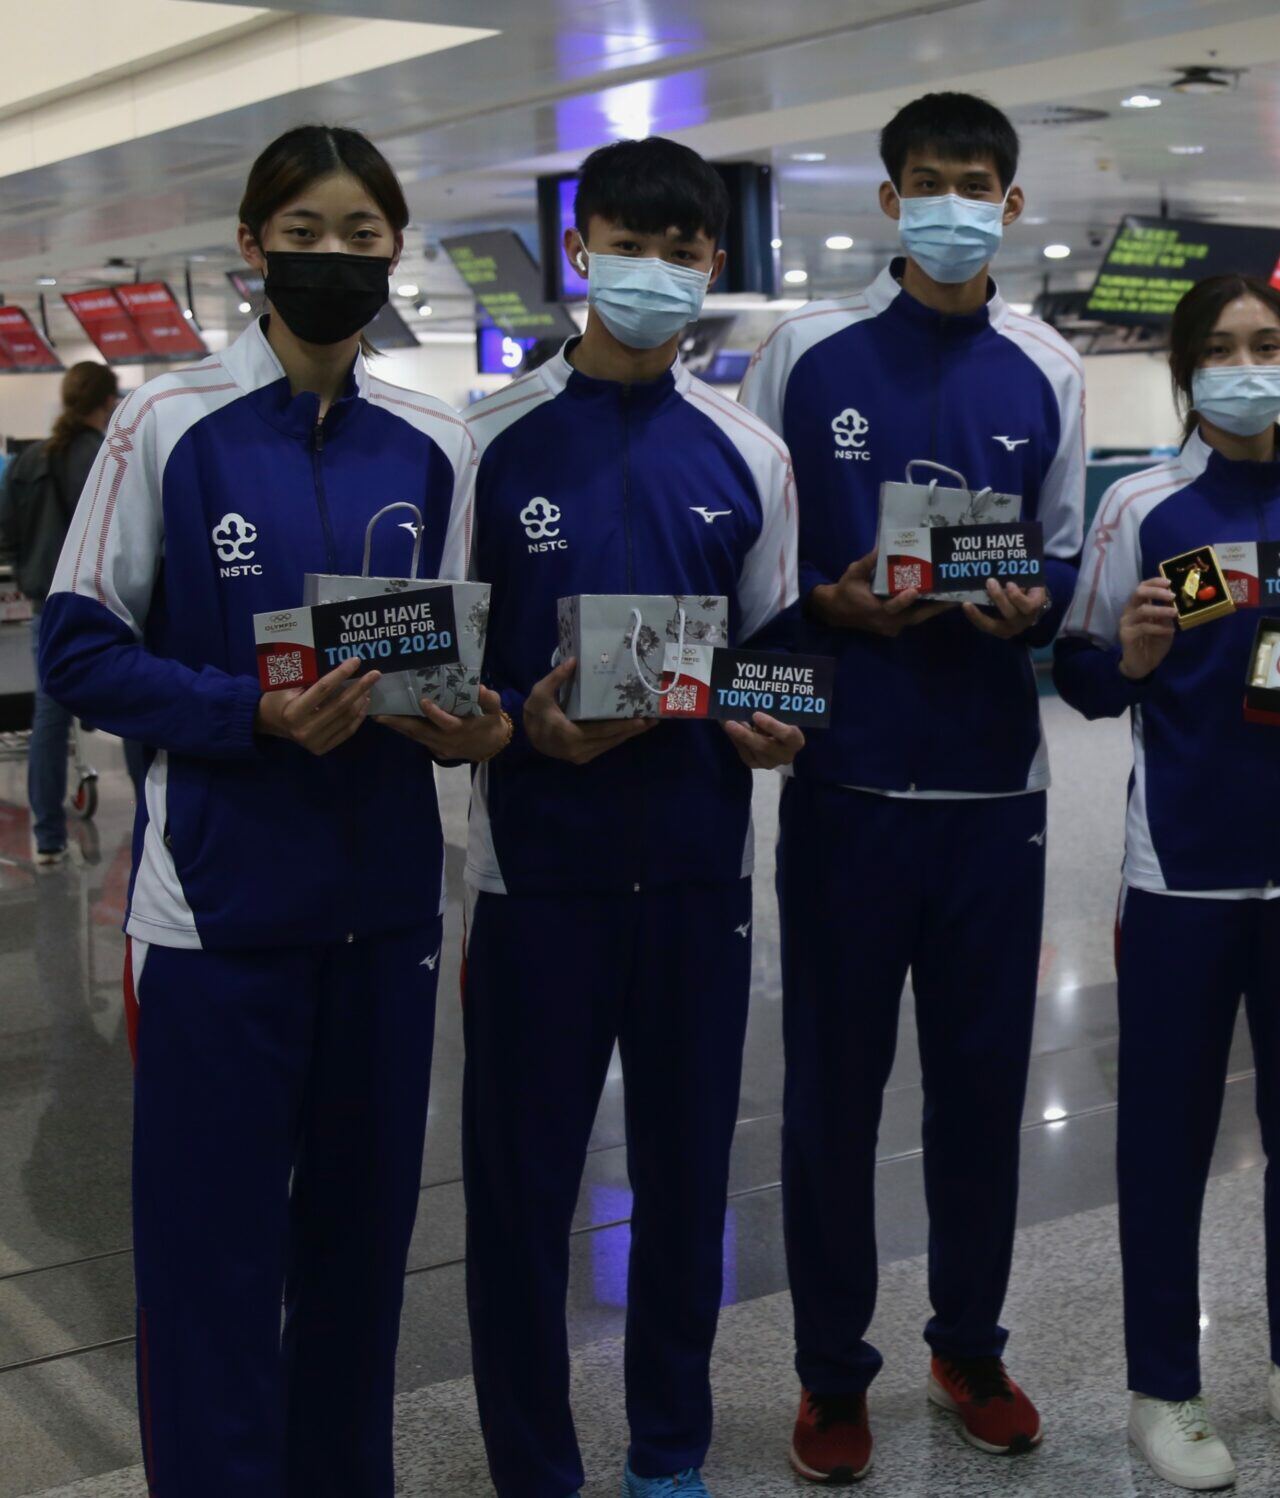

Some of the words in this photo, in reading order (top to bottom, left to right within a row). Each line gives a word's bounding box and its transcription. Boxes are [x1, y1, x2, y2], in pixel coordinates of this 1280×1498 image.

[835, 450, 871, 461] NSTC
[528, 540, 568, 553] NSTC
[953, 536, 981, 550] YOU
[986, 534, 1024, 548] HAVE
[951, 549, 1004, 562] QUALIFIED
[1007, 549, 1027, 559] FOR
[219, 565, 263, 578] NSTC
[939, 561, 992, 579] TOKYO
[997, 560, 1039, 575] 2020
[340, 612, 377, 630] YOU
[384, 603, 431, 624] HAVE
[340, 625, 407, 644] QUALIFIED
[410, 620, 435, 635] FOR
[325, 639, 392, 665] TOKYO
[401, 631, 451, 655] 2020
[736, 662, 766, 679] YOU
[772, 666, 813, 683] HAVE
[732, 678, 789, 693] QUALIFIED
[793, 683, 814, 695] FOR
[718, 690, 774, 709] TOKYO
[780, 695, 826, 713] 2020
